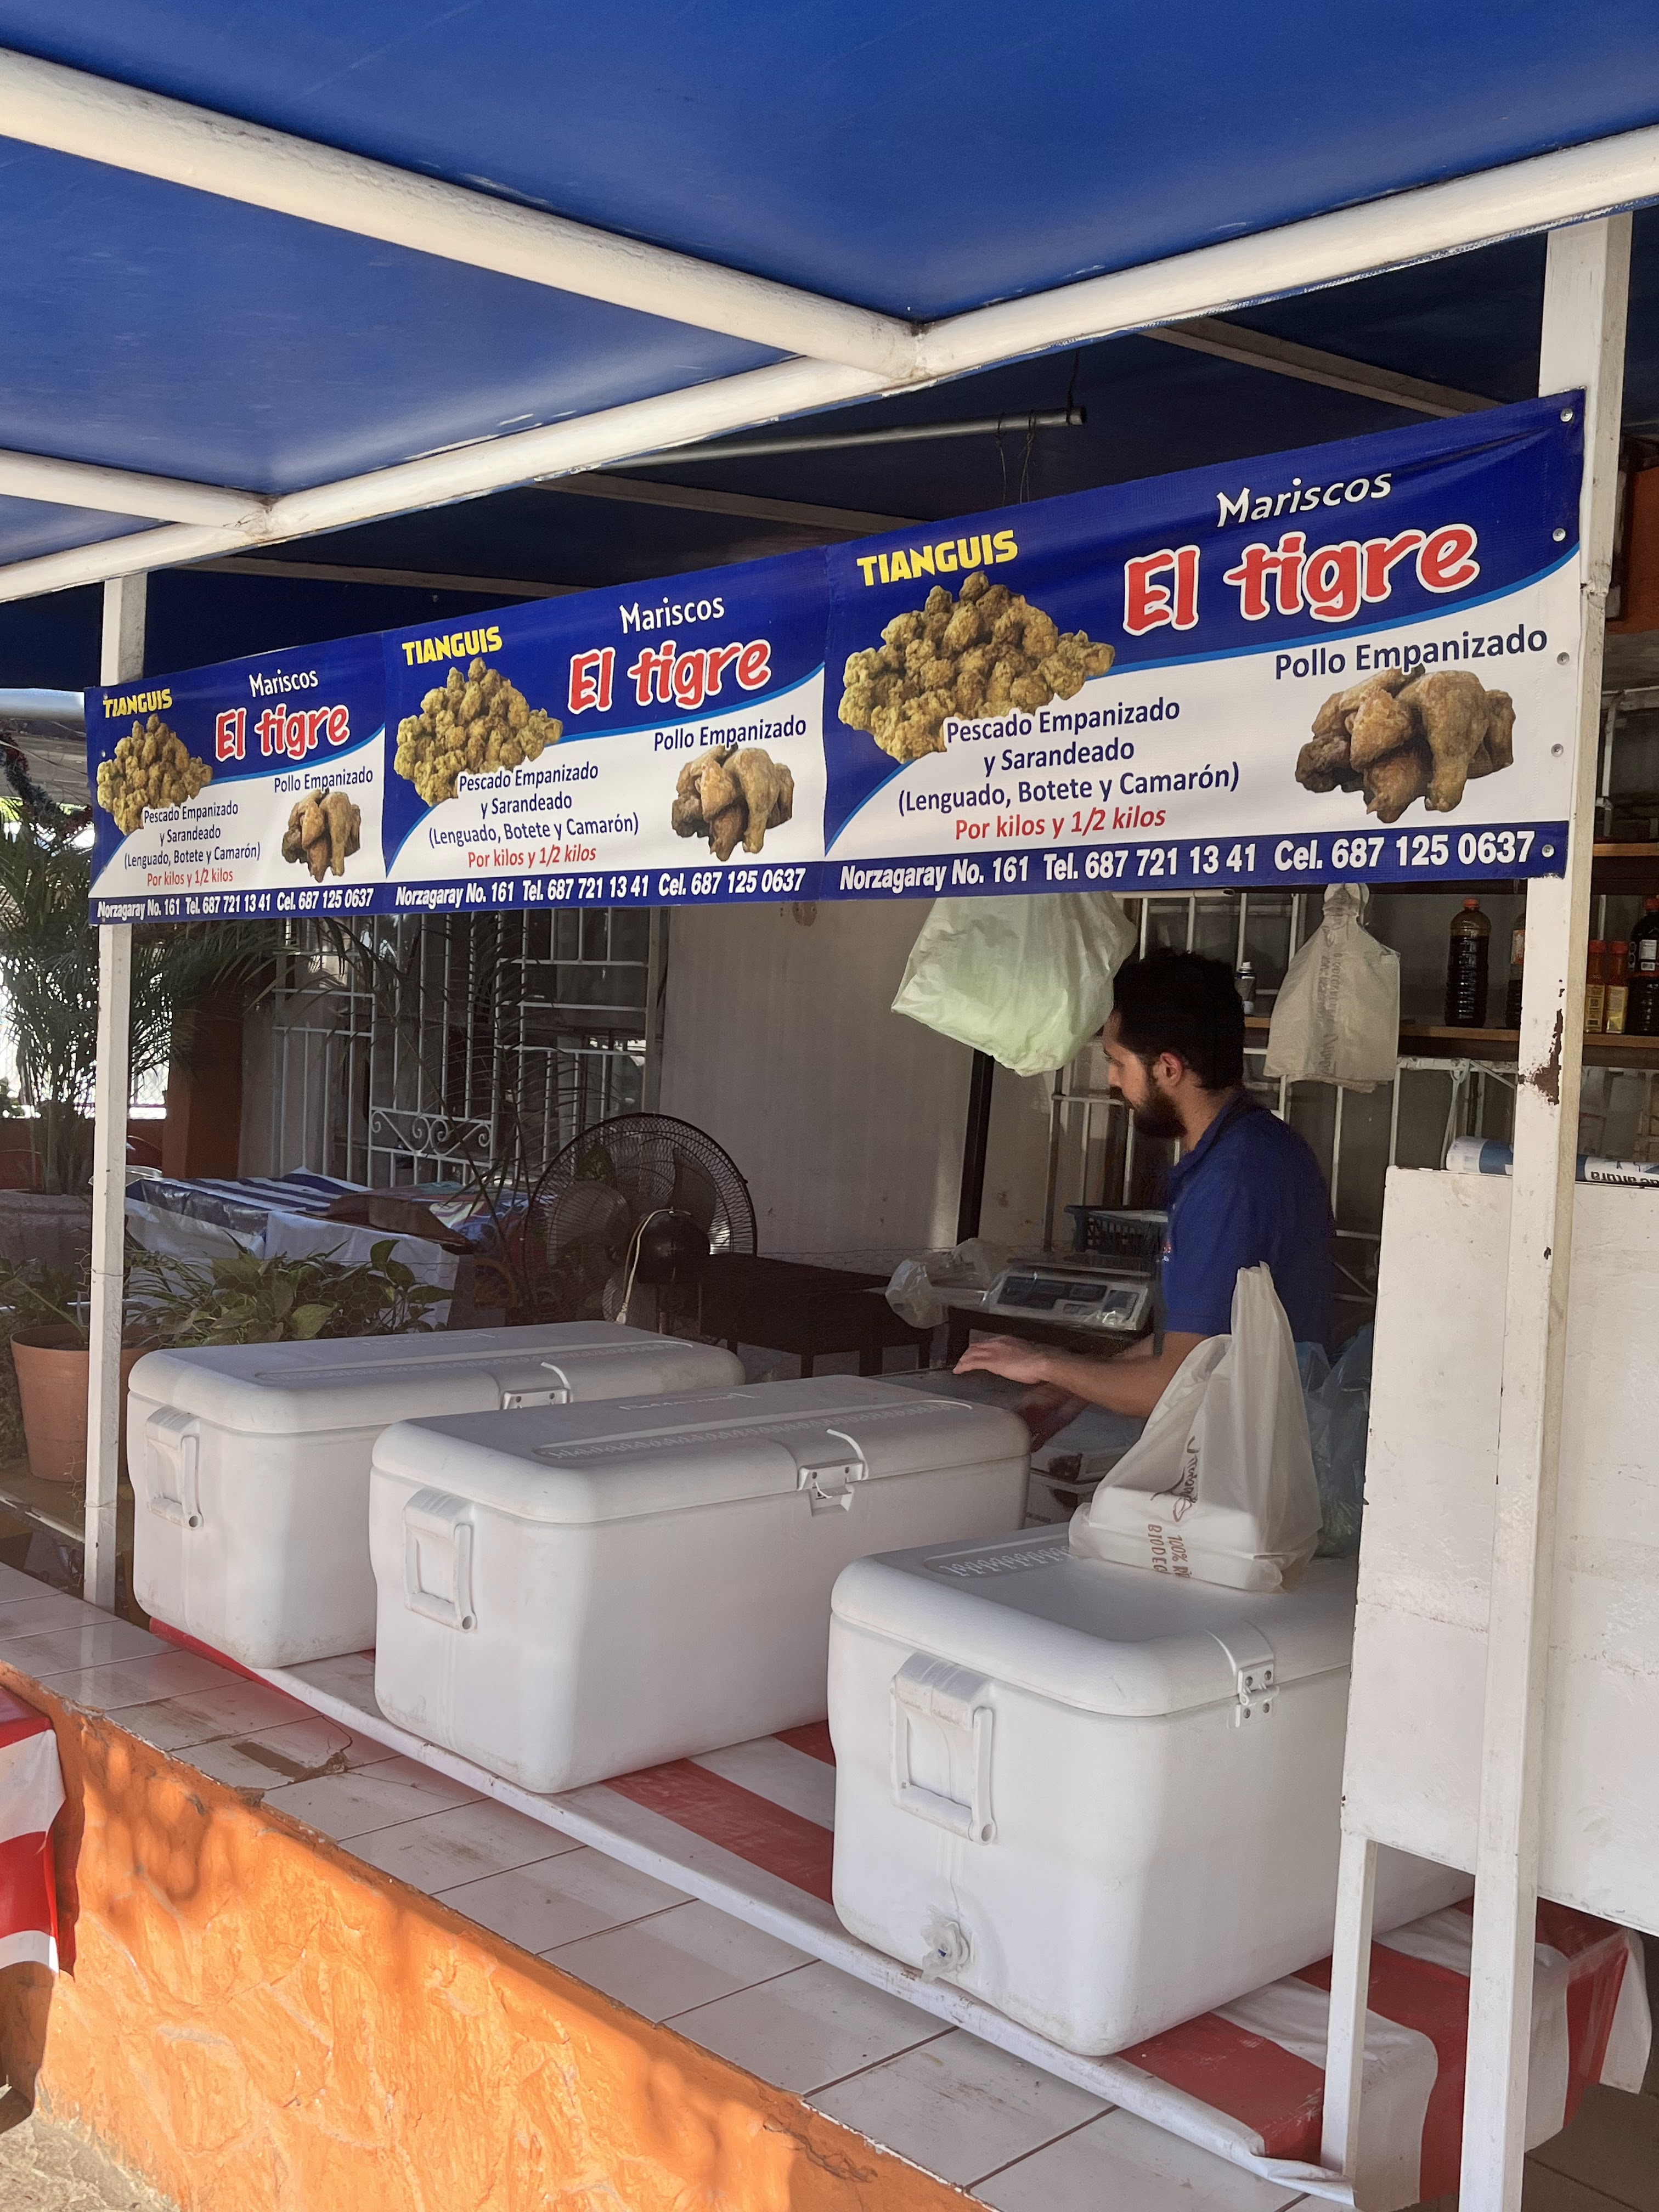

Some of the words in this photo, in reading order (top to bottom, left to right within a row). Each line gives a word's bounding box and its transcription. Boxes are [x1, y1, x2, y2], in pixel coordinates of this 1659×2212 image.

[1217, 473, 1391, 527] Mariscos
[857, 531, 1017, 588] TIANGUIS
[1123, 545, 1200, 636] El
[1223, 524, 1481, 624] tigre
[619, 597, 724, 633] Mariscos
[403, 627, 501, 667] TIANGUIS
[1275, 646, 1345, 679] Pollo
[1356, 623, 1547, 672] Empanizado
[249, 669, 318, 697] Mariscos
[568, 647, 616, 714] El
[627, 640, 772, 711] tigre
[104, 690, 172, 719] TIANGUIS
[946, 712, 1031, 743] Pescado
[1039, 696, 1180, 735] Empanizado
[216, 708, 246, 761] El
[255, 703, 351, 761] tigre
[655, 730, 693, 751] Pollo
[699, 714, 806, 748] Empanizado
[984, 756, 995, 776] y
[1002, 737, 1134, 770] Sarandeado
[275, 775, 300, 792] Pollo
[305, 766, 373, 791] Empanizado
[459, 769, 510, 791] Pescado
[515, 762, 598, 788] Empanizado
[899, 783, 1011, 816] (Lenguado,
[1019, 779, 1092, 802] Botete
[1099, 780, 1112, 802] y
[1120, 761, 1238, 794] Camarón)
[144, 804, 179, 823] Pescado
[183, 800, 238, 821] Empanizado
[481, 803, 487, 819] y
[492, 792, 572, 814] Sarandeado
[956, 820, 990, 840] Por
[997, 814, 1045, 838] kilos
[1052, 818, 1064, 839] y
[1071, 808, 1105, 835] 1/2
[1113, 805, 1166, 829] kilos
[160, 833, 165, 847] y
[167, 825, 221, 842] Sarandeado
[430, 825, 500, 848] (Lenguado,
[504, 823, 550, 839] Botete
[554, 824, 561, 840] y
[567, 812, 638, 835] Camarón)
[125, 852, 170, 869] (Lenguado,
[174, 850, 203, 863] Botete
[206, 851, 211, 862] y
[215, 843, 259, 860] Camarón)
[469, 852, 489, 867] Por
[494, 849, 524, 866] kilos
[528, 853, 535, 867] y
[540, 845, 561, 865] 1/2
[565, 845, 596, 861] kilos
[840, 866, 946, 893] Norzagaray
[952, 859, 984, 884] No.
[993, 856, 1028, 882] 161
[1043, 853, 1078, 880] Tel.
[1086, 850, 1128, 878] 687
[1137, 848, 1177, 876] 721
[1275, 840, 1322, 871] Cel.
[1332, 837, 1384, 868] 687
[1396, 834, 1448, 866] 125
[1458, 831, 1534, 864] 0637
[148, 874, 161, 885] Por
[165, 871, 183, 884] kilos
[187, 874, 192, 886] y
[196, 869, 208, 884] 1/2
[212, 868, 233, 882] kilos
[396, 887, 463, 909] Norzagaray
[466, 883, 486, 902] No.
[492, 882, 514, 901] 161
[523, 880, 543, 901] Tel.
[548, 878, 574, 900] 687
[579, 877, 602, 899] 721
[659, 873, 686, 896] Cel.
[691, 872, 721, 895] 687
[729, 871, 758, 893] 125
[761, 868, 806, 892] 0637
[97, 901, 145, 922] Norzagaray
[148, 899, 161, 916] No.
[165, 898, 179, 915] 161
[185, 897, 200, 914] Tel.
[203, 896, 221, 913] 687
[223, 895, 240, 912] 721
[277, 892, 296, 911] Cel.
[299, 891, 319, 910] 687
[323, 890, 343, 908] 125
[345, 888, 374, 907] 0637
